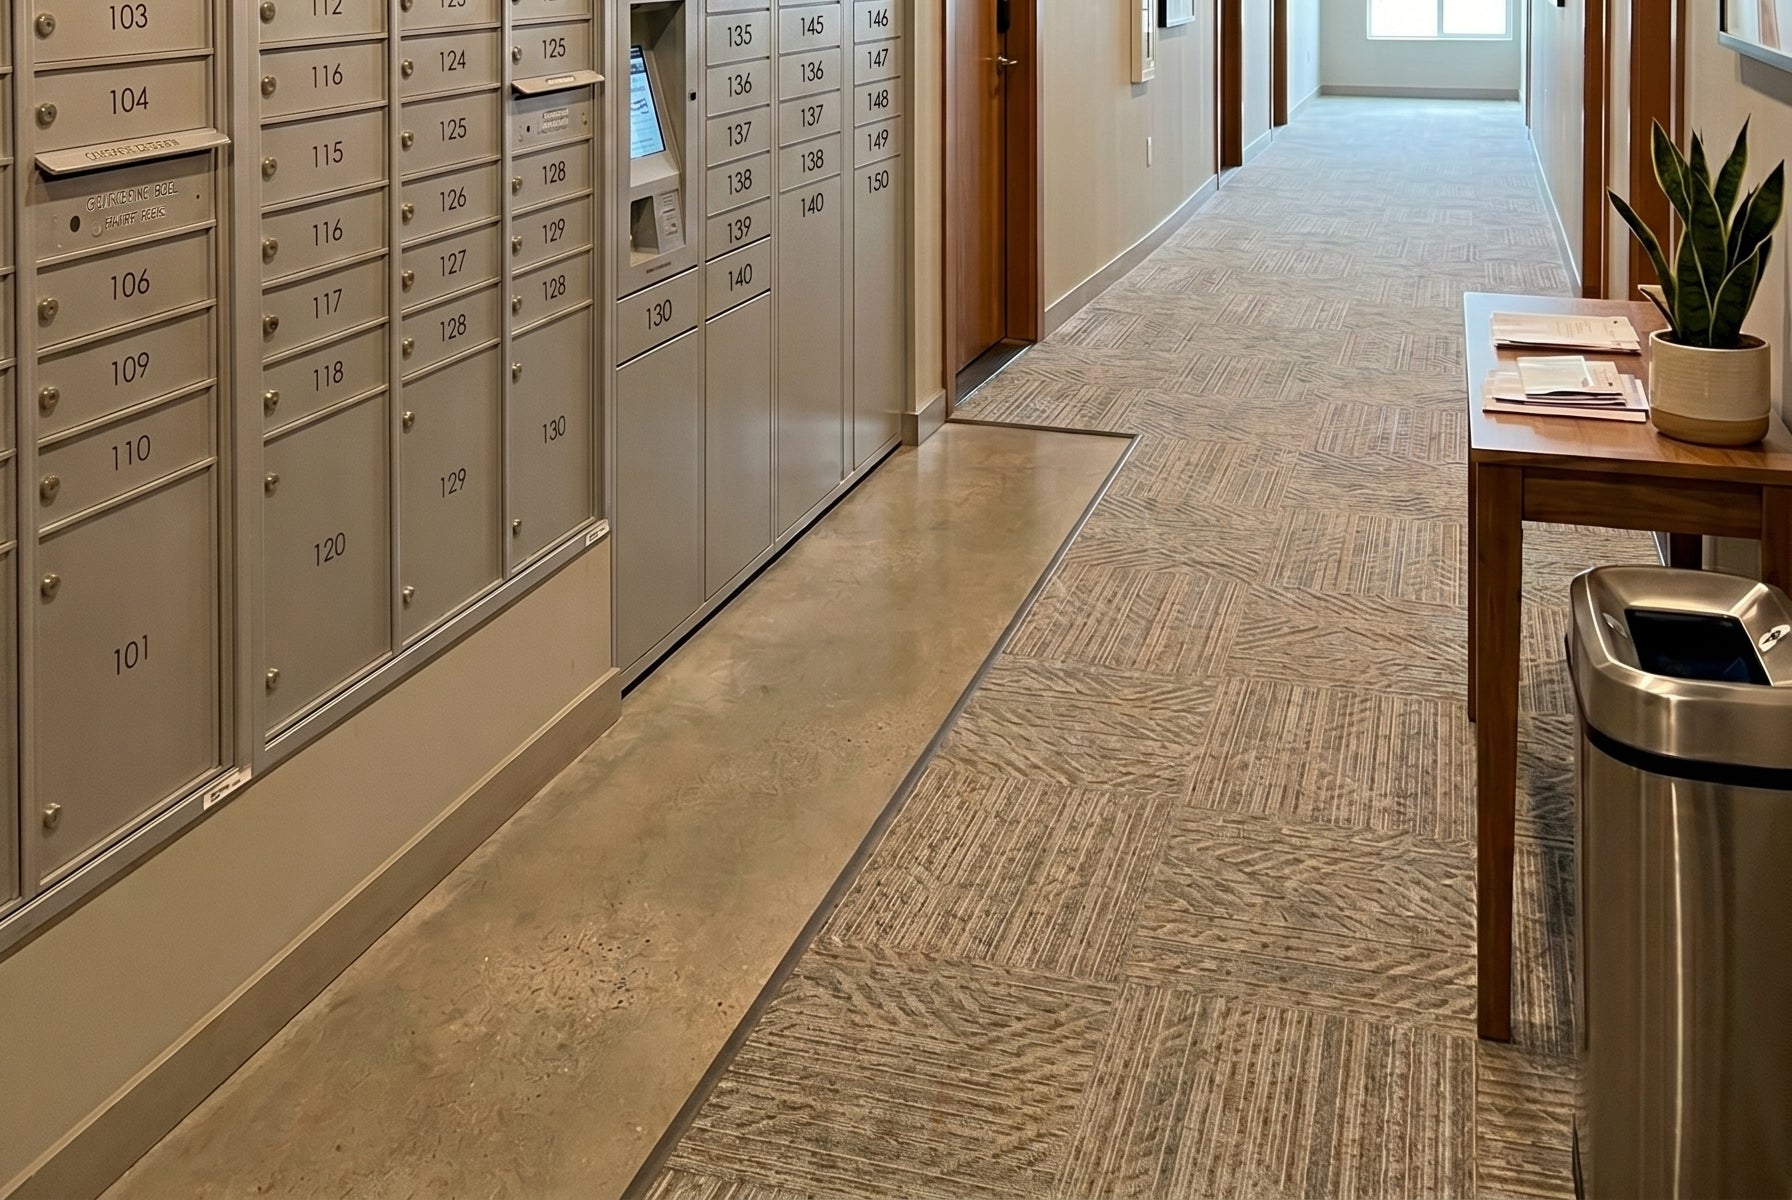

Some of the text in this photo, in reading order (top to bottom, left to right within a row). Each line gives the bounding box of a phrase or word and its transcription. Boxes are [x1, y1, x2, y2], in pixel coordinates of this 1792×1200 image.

[109, 3, 148, 30] 103
[800, 15, 824, 37] 145
[867, 8, 889, 29] 146
[542, 37, 566, 59] 125
[727, 23, 752, 48] 135
[439, 49, 467, 72] 124
[800, 60, 824, 83] 136
[867, 48, 889, 69] 147
[312, 63, 343, 89] 116
[727, 72, 753, 97] 136
[110, 86, 149, 115] 104
[867, 89, 889, 111] 148
[800, 103, 824, 128] 137
[439, 117, 467, 142] 125
[727, 121, 752, 147] 137
[867, 128, 889, 152] 149
[312, 140, 344, 168] 115
[801, 148, 824, 173] 138
[542, 160, 566, 185] 128
[727, 168, 753, 195] 138
[867, 169, 889, 194] 150
[440, 186, 467, 213] 126
[800, 192, 824, 218] 140
[312, 218, 343, 247] 116
[542, 218, 566, 244] 129
[727, 215, 752, 244] 139
[440, 249, 467, 277] 127
[111, 268, 150, 301] 106
[542, 274, 566, 301] 128
[728, 263, 753, 292] 140
[313, 288, 343, 319] 117
[646, 299, 673, 330] 130
[440, 313, 467, 342] 128
[111, 351, 150, 386] 109
[313, 360, 344, 392] 118
[542, 415, 566, 444] 130
[112, 434, 151, 471] 110
[440, 467, 467, 498] 129
[314, 532, 346, 567] 120
[114, 634, 148, 676] 101
